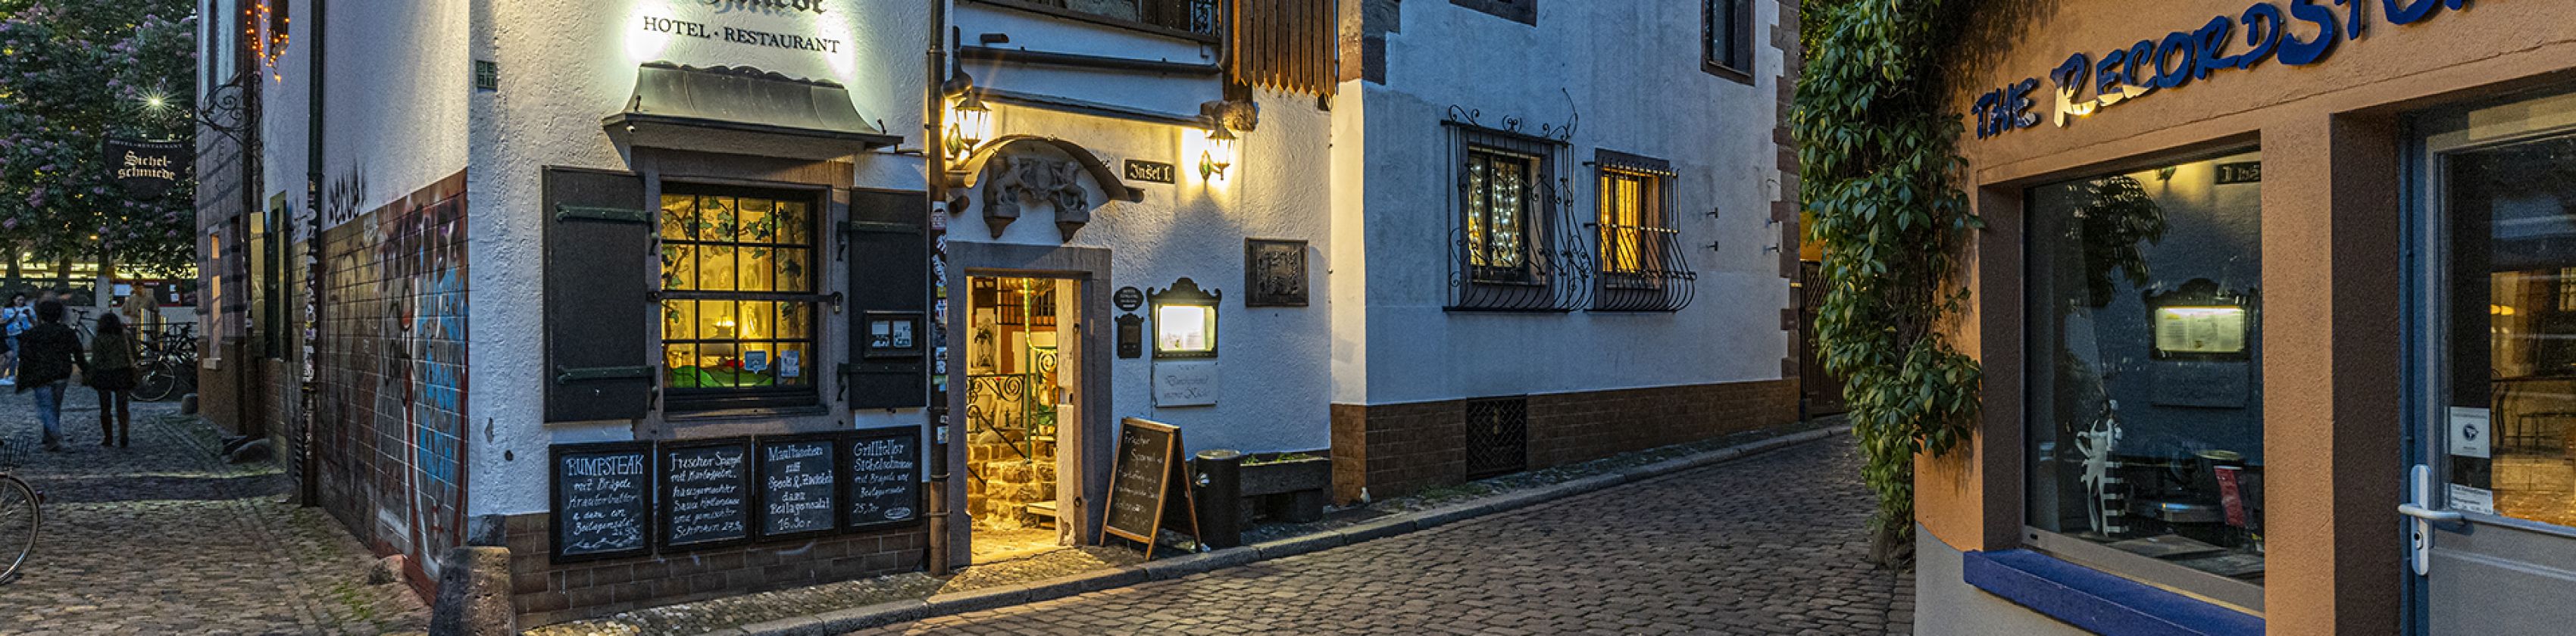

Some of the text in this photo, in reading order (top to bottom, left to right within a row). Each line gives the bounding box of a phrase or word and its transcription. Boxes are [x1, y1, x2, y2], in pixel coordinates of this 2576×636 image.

[643, 16, 839, 54] HOTEL RESTAURANT
[1971, 77, 2040, 140] THE
[123, 150, 173, 167] Sichel-
[117, 165, 176, 181] schmiede
[566, 455, 644, 476] RUMPSTEAK
